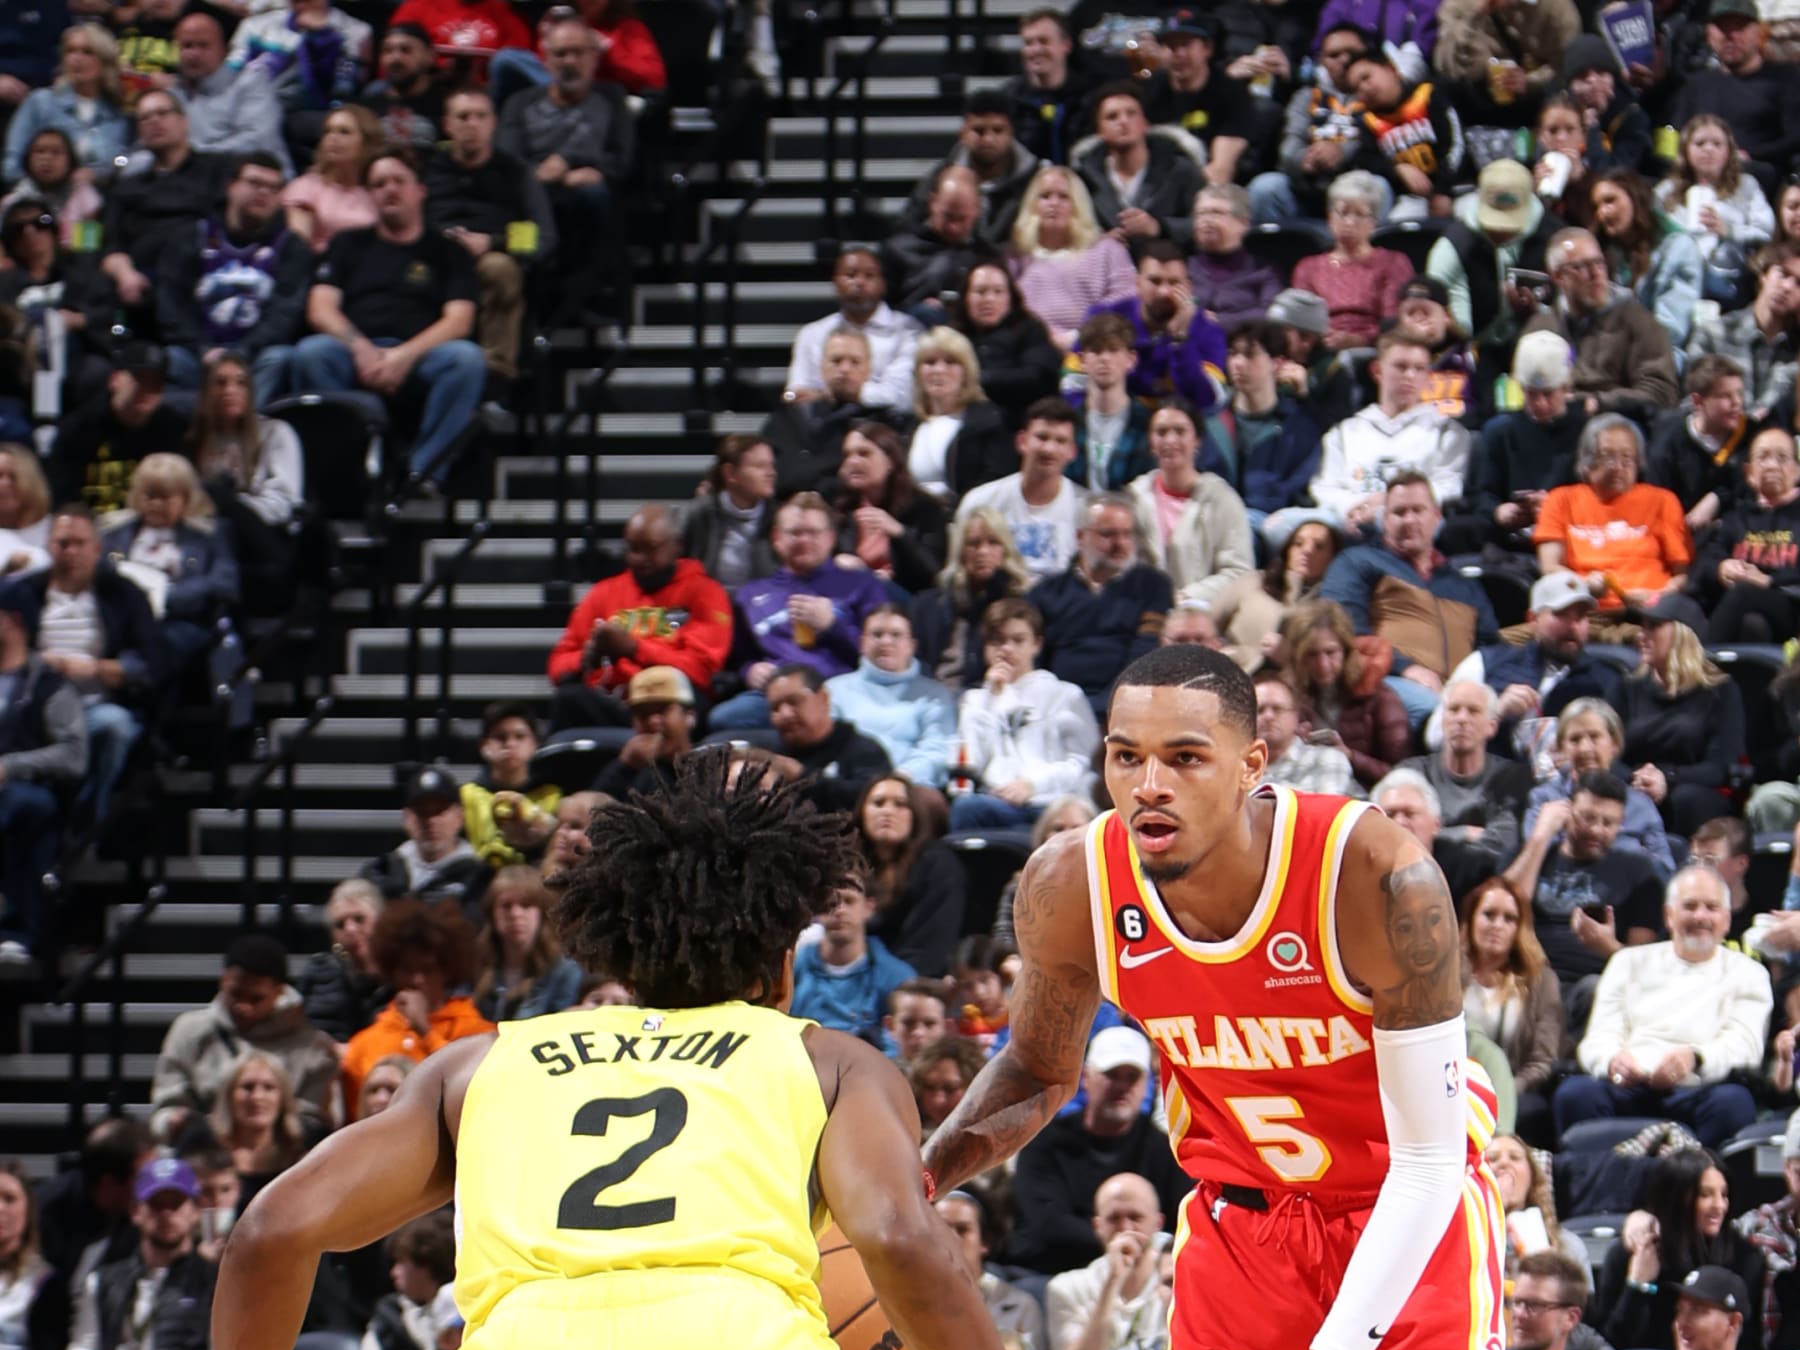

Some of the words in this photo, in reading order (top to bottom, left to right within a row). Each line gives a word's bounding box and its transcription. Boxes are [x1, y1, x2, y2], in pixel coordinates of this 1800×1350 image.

[1123, 909, 1143, 939] 6
[1264, 974, 1322, 989] sharecare
[530, 1030, 751, 1077] SEXTON
[1143, 1014, 1372, 1071] TLANTA
[556, 1086, 688, 1231] 2
[1223, 1095, 1333, 1182] 5
